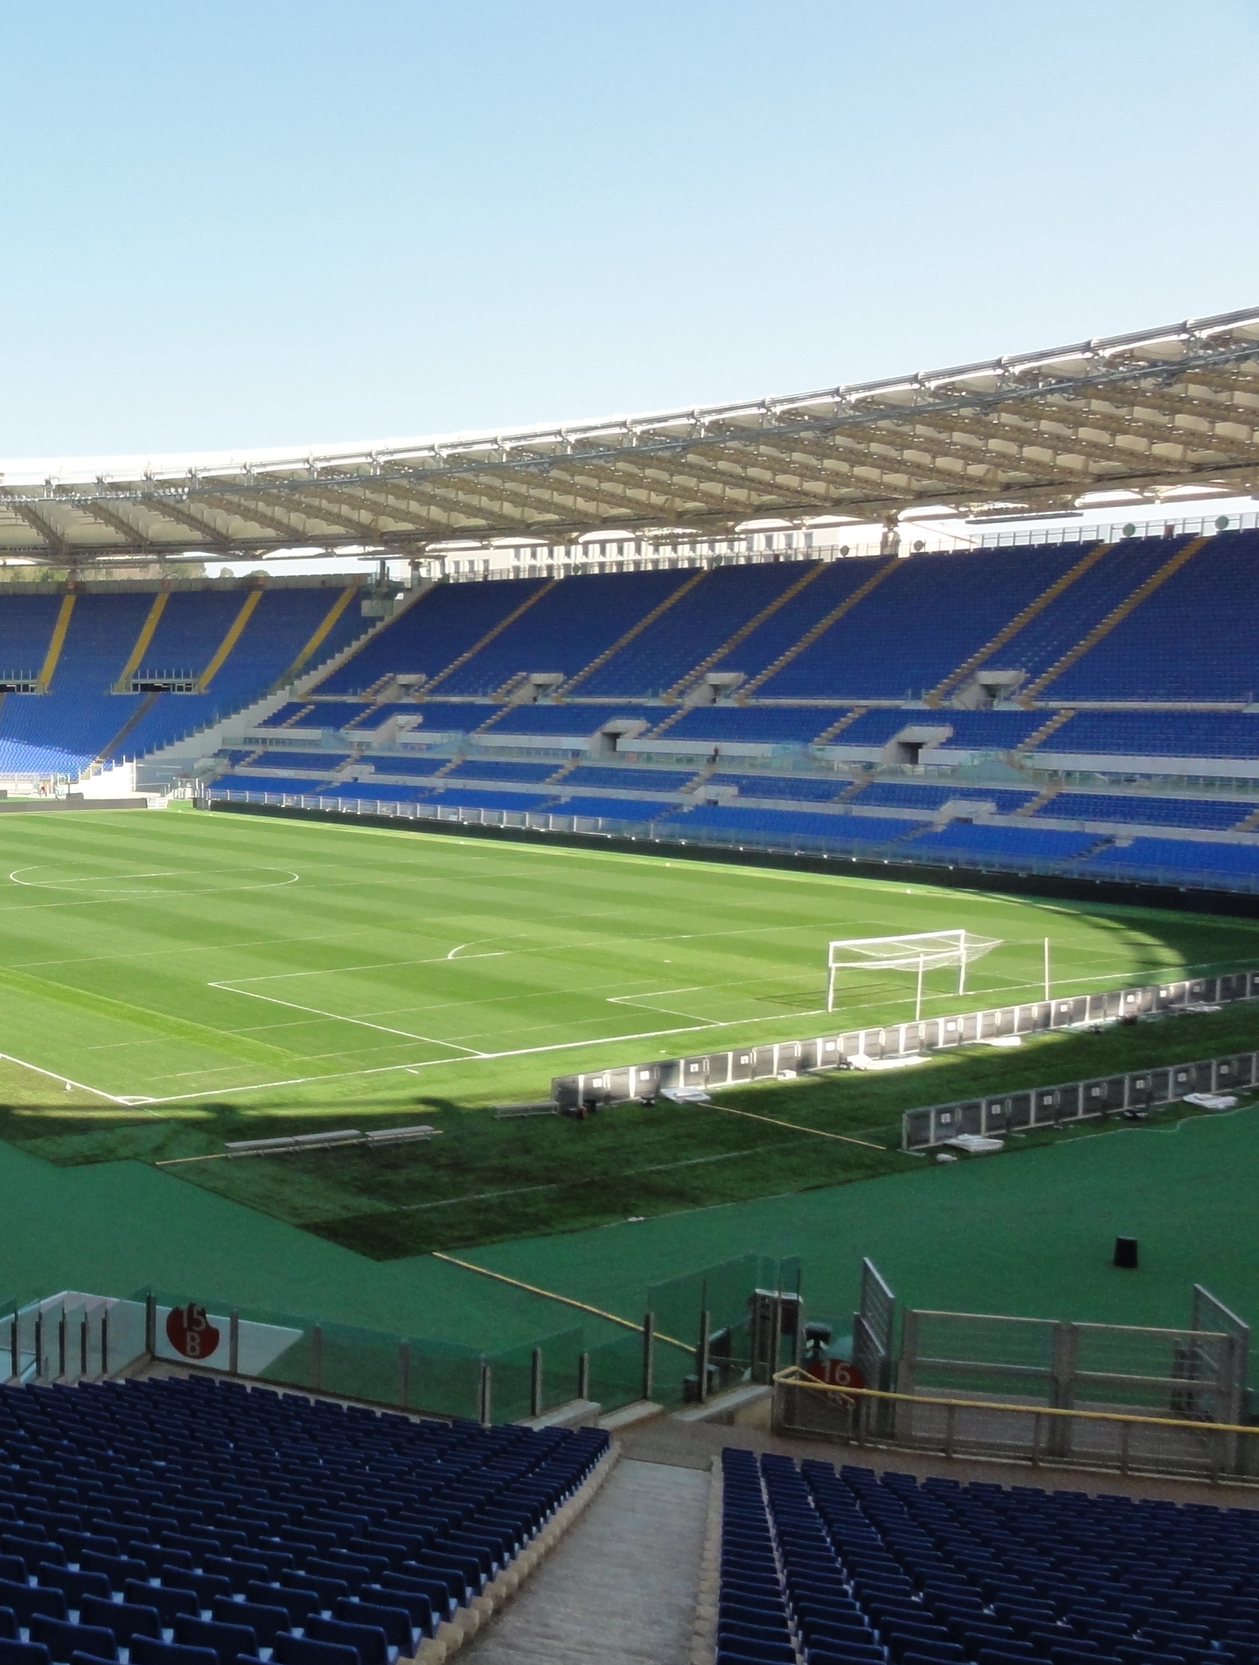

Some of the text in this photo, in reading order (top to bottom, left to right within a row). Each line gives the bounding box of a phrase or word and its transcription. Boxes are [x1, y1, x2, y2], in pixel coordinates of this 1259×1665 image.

[180, 1305, 206, 1331] 15
[186, 1331, 201, 1356] B
[821, 1359, 851, 1386] 16
